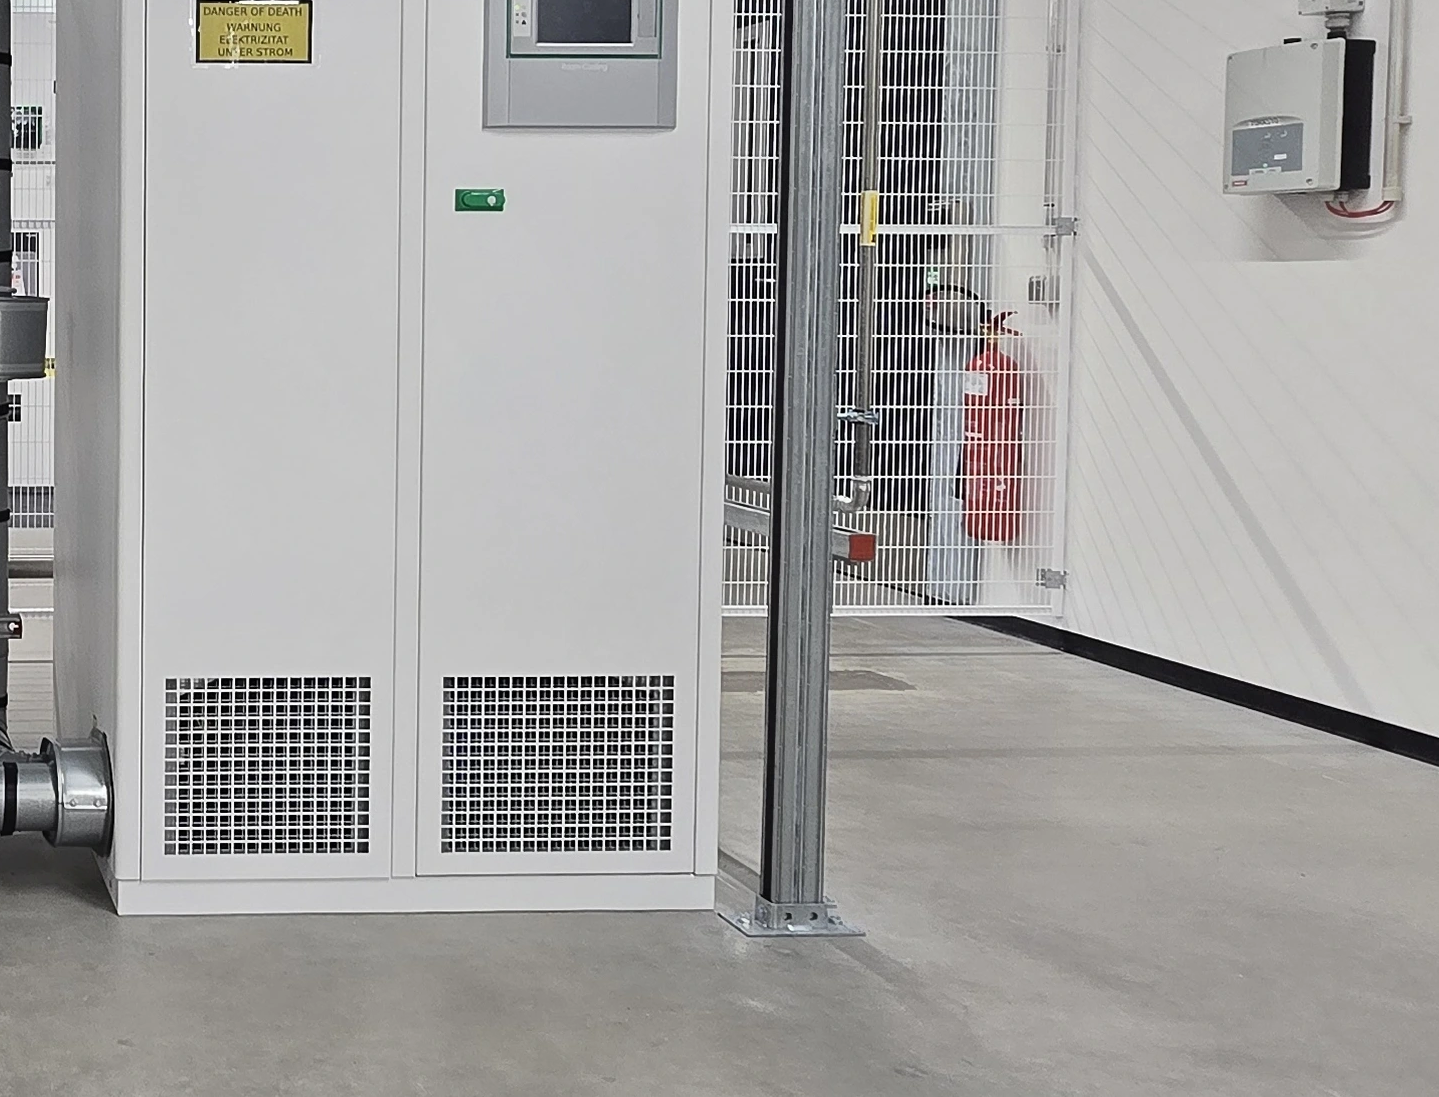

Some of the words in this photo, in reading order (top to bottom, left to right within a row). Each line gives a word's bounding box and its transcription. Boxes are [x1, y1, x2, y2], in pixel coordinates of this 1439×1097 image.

[203, 7, 247, 16] DANGER
[250, 7, 265, 16] OF
[267, 7, 303, 17] DEATH
[226, 23, 281, 32] WARNUNG
[217, 48, 253, 57] UNER
[256, 48, 293, 57] STROM
